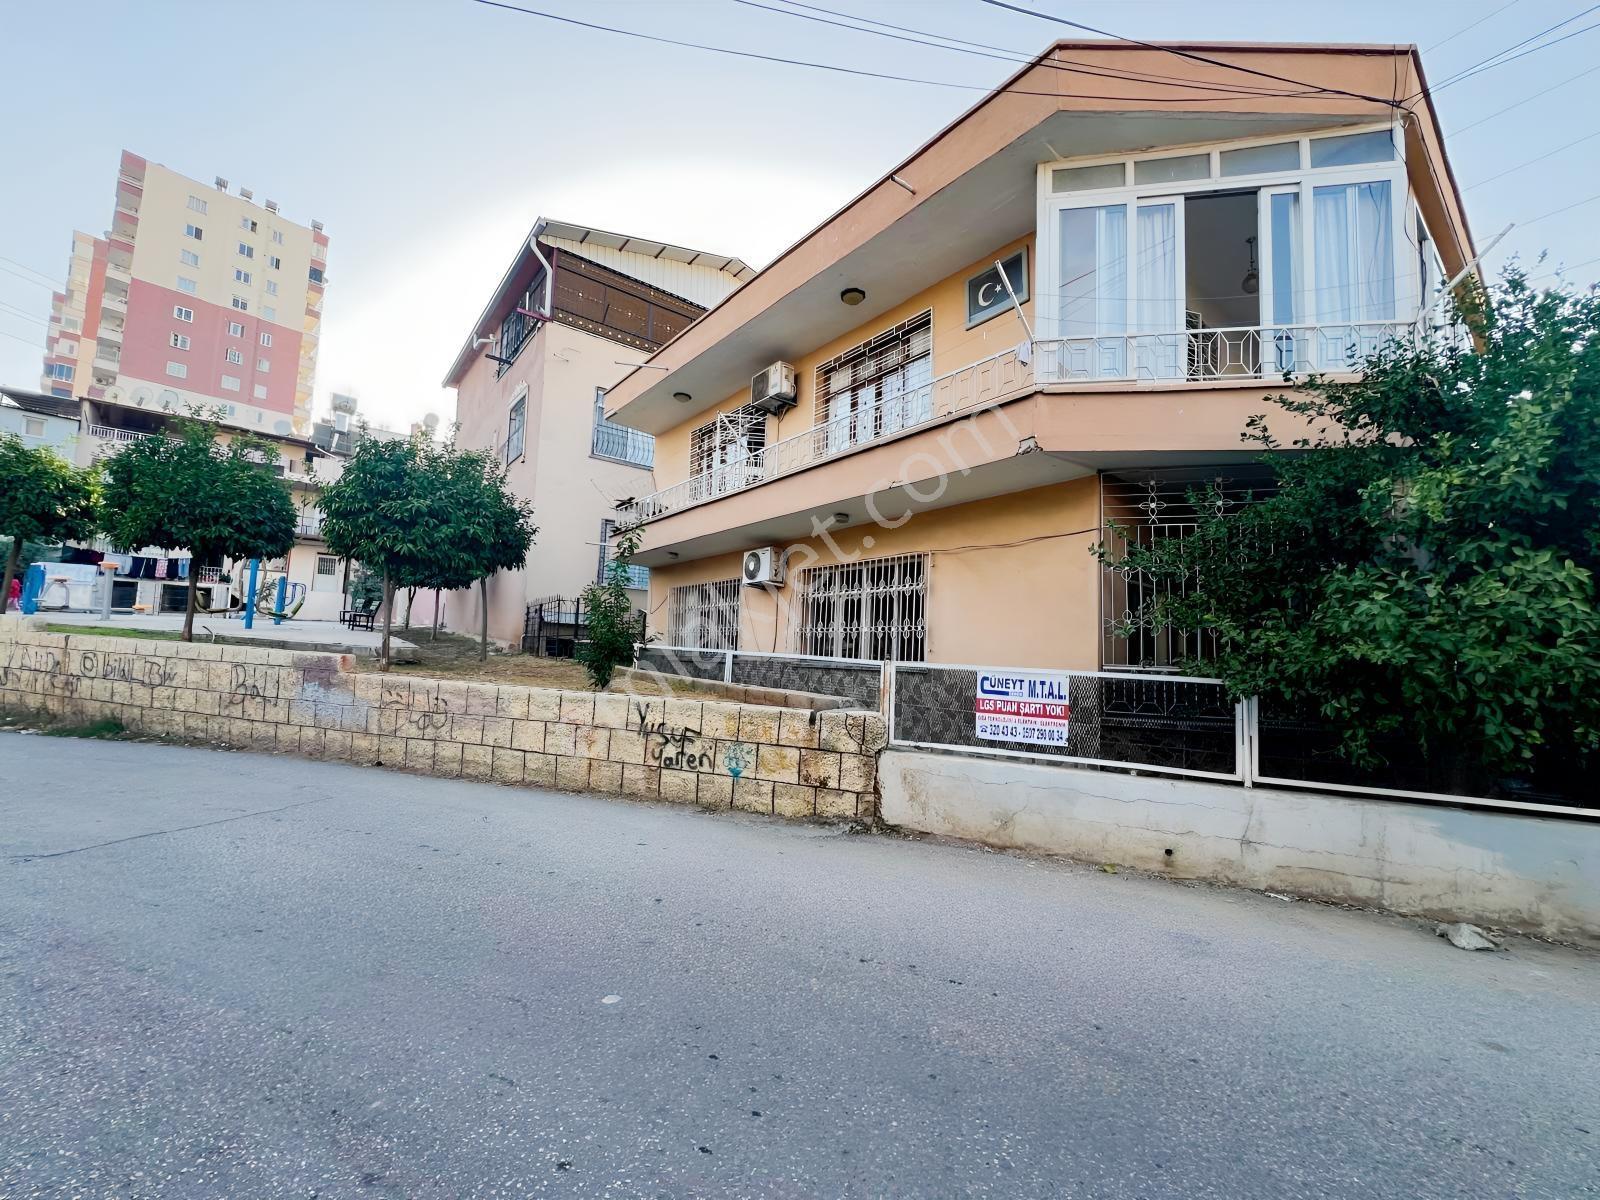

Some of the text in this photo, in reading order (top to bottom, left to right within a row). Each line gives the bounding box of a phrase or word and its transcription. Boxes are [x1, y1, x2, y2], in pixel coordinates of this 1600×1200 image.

[980, 674, 1067, 700] CÜNEYT M.T.A.L.
[979, 699, 1065, 717] LGS PUAN ŞARTI YOK!
[989, 724, 1000, 736] 320
[1001, 725, 1009, 737] 43
[1010, 726, 1018, 738] 43
